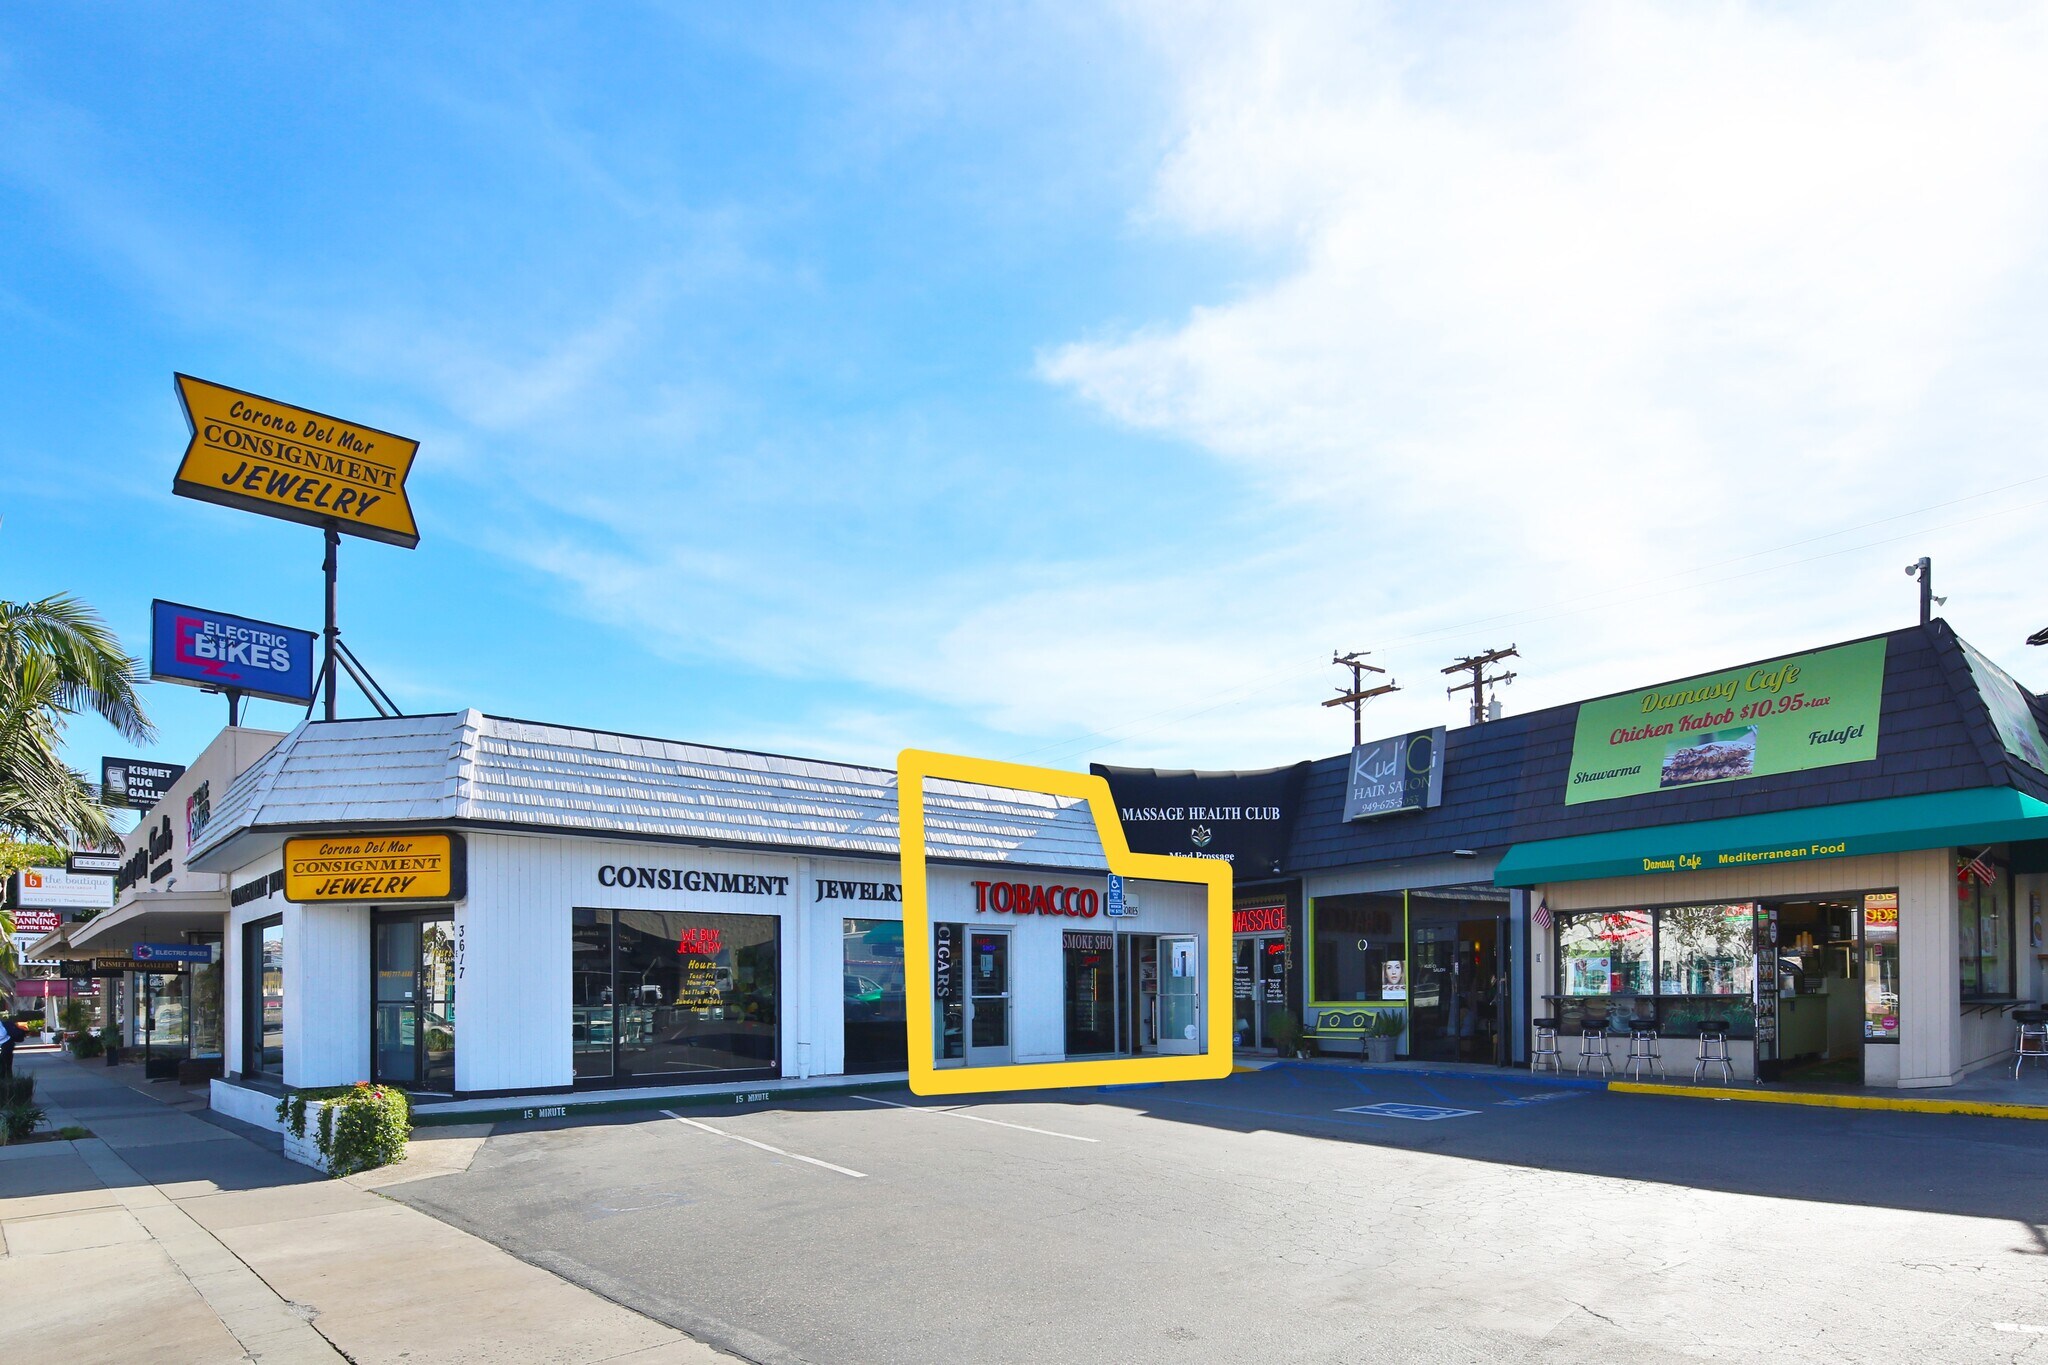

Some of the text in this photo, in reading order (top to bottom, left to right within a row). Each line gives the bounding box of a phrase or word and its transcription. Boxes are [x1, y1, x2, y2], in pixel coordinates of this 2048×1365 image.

[230, 401, 374, 455] Corona Del Mar
[204, 424, 396, 488] CONSIGNMENT
[221, 461, 381, 517] JEWELRY
[203, 620, 288, 649] ELECTRIC
[1744, 663, 1801, 693] Cafe
[1609, 722, 1674, 746] Chicken
[1678, 706, 1734, 731] Kabob
[1808, 724, 1865, 746] Falafel
[129, 765, 172, 778] KISMET
[1573, 765, 1641, 785] Shawarma
[129, 776, 153, 788] RUG
[1353, 774, 1432, 800] HAIR SALON
[129, 788, 167, 799] GALLE
[1122, 806, 1281, 821] MASSAGE HEALTH CLUB
[319, 840, 413, 855] Corona Del Mar
[1679, 854, 1702, 869] Cafe
[1718, 847, 1807, 864] Mediterranean
[1811, 842, 1845, 855] Food
[292, 857, 441, 874] CONSIGNMENT
[45, 874, 110, 890] the boutique
[315, 875, 417, 896] JEWELRY
[598, 865, 789, 896] CONSIGNMENT
[971, 881, 1099, 919] TOBACCO
[14, 917, 58, 926] TANNING
[1232, 907, 1286, 932] MASSAGE
[681, 928, 720, 941] WE BUY
[1063, 933, 1113, 950] SMOKE SHO
[677, 941, 722, 954] JEWELRY
[688, 960, 717, 970] Hours
[937, 926, 951, 998] CIGARS
[735, 1092, 770, 1104] 15 MINUTE
[523, 1106, 567, 1119] 15 MINUTE
